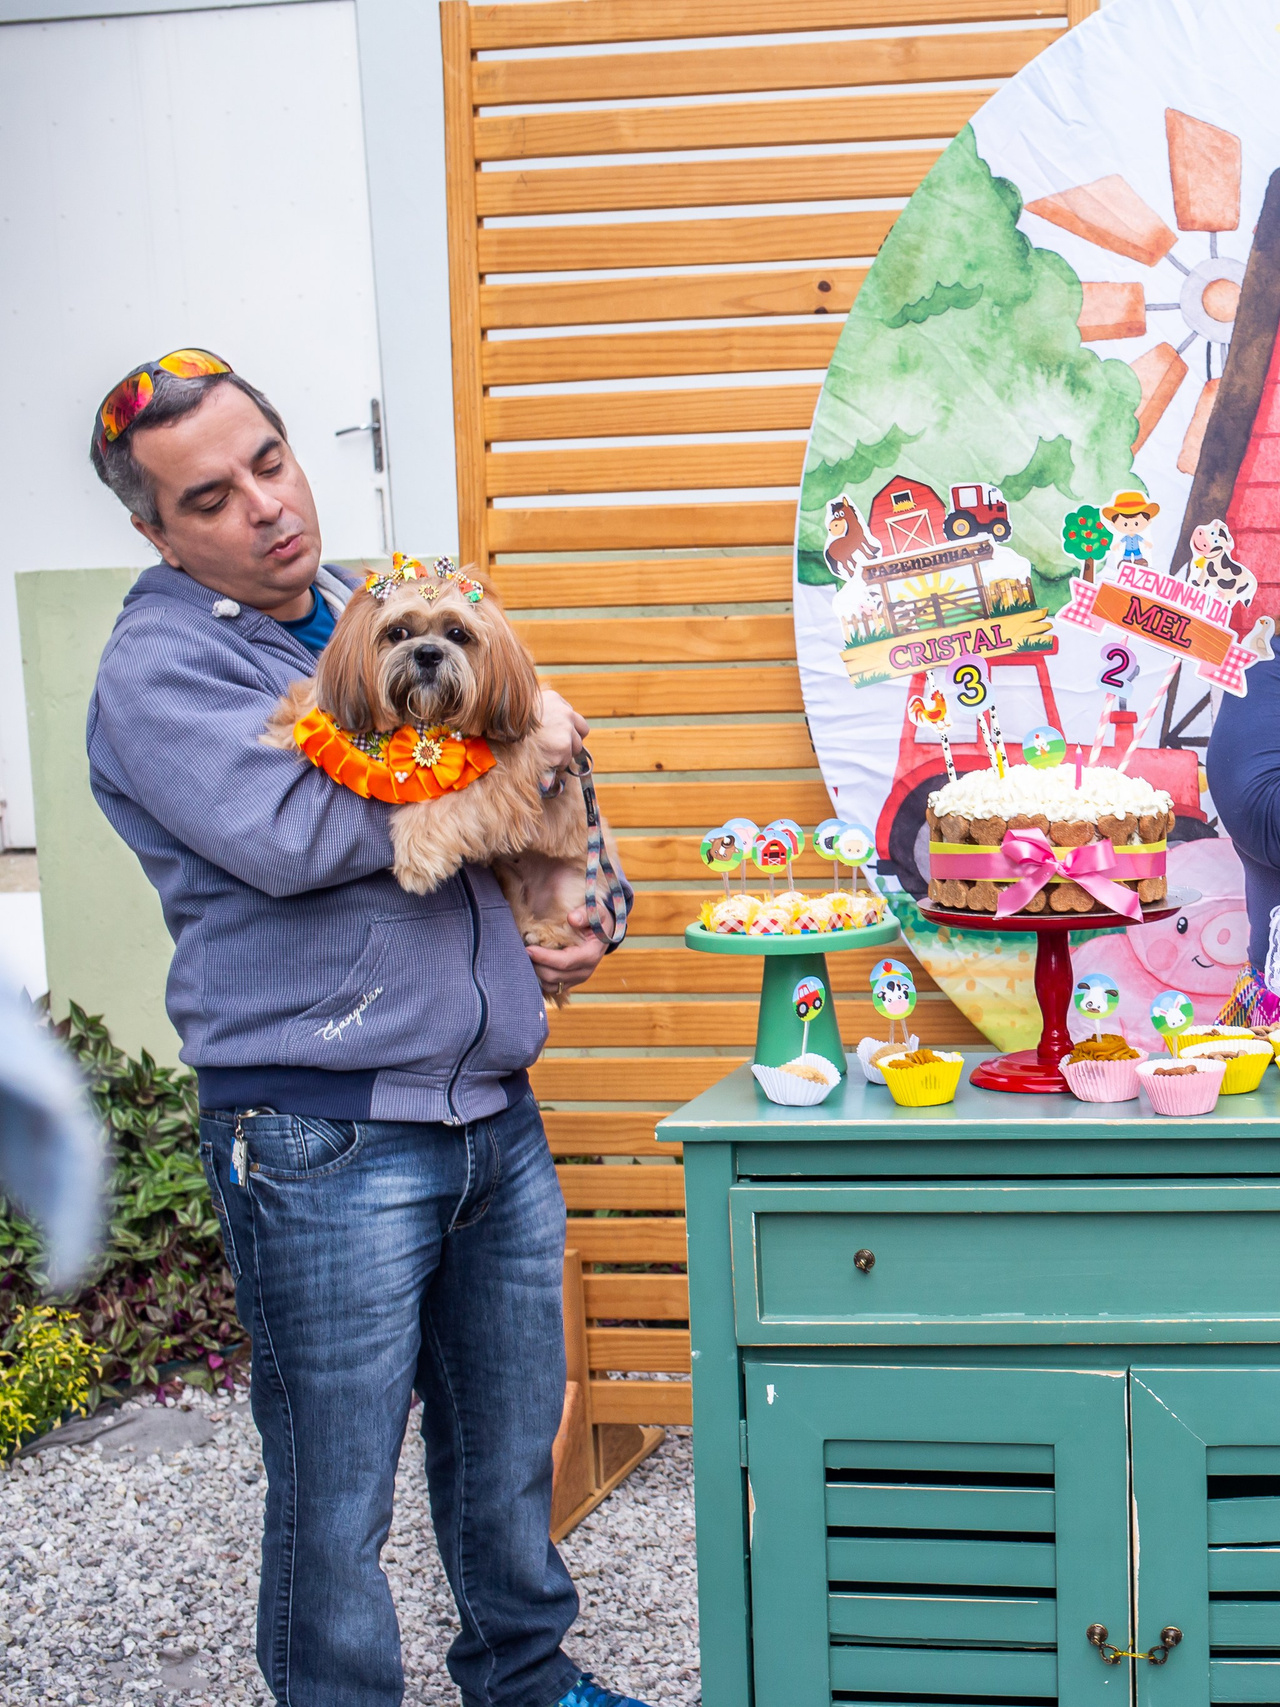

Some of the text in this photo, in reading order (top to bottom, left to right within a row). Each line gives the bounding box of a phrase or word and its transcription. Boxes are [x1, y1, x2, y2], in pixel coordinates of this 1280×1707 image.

[866, 547, 972, 580] FAZENDINHA
[1117, 565, 1229, 628] FAZENDINHA DA
[1122, 595, 1192, 649] MEL
[889, 624, 1013, 670] CRISTAL
[1101, 648, 1130, 688] 2
[953, 664, 987, 707] 3
[313, 986, 384, 1041] Gangster
